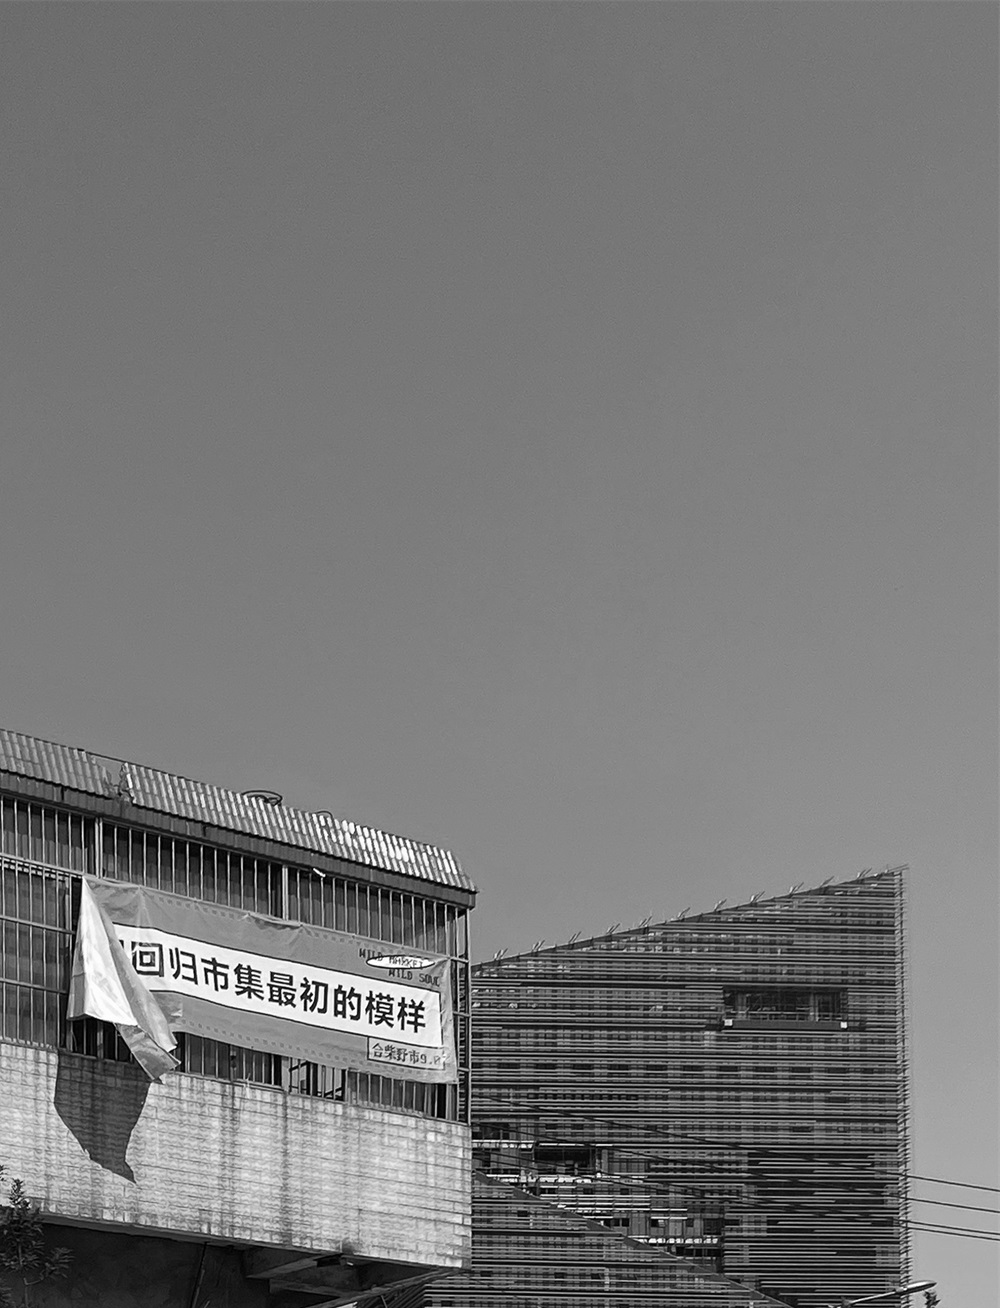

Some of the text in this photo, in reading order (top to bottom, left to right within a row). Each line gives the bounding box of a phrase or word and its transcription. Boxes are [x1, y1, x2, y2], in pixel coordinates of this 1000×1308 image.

[359, 947, 383, 962] WILD
[388, 969, 413, 981] WILD
[118, 938, 426, 1034] 回归市集最初的模样
